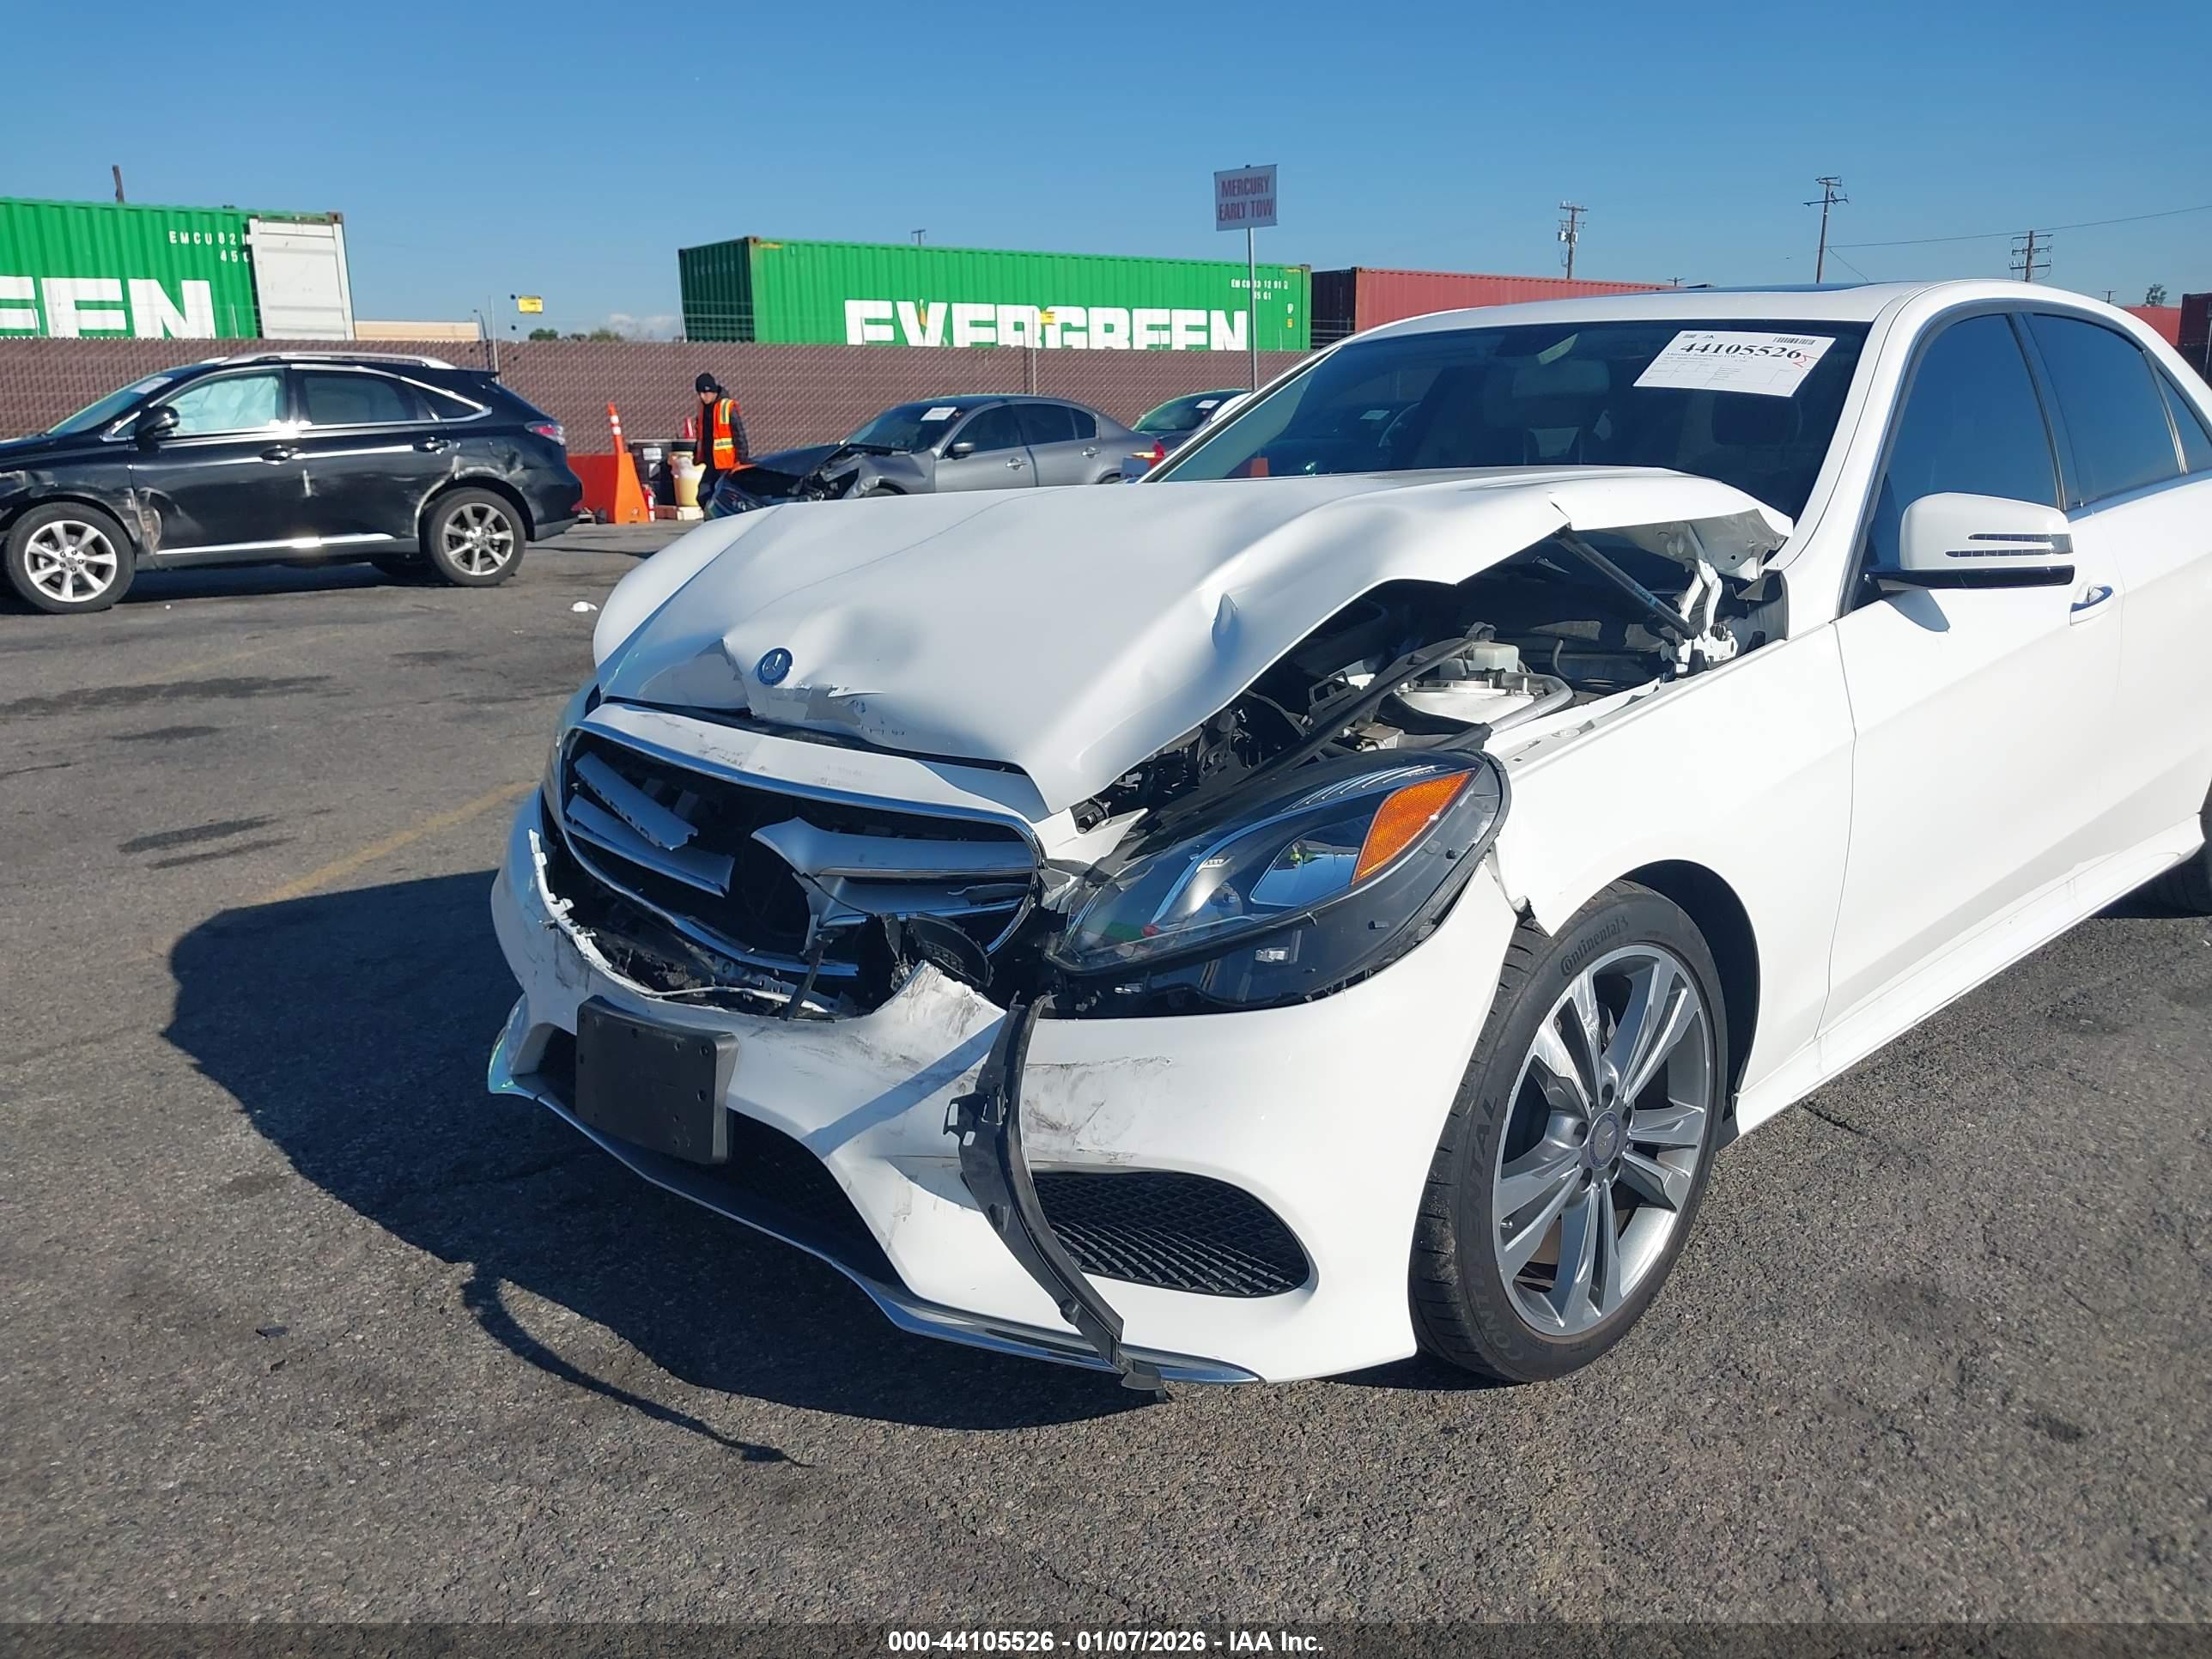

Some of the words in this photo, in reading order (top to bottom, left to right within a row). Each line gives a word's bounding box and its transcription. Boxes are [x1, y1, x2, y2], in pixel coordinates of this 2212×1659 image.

[1222, 175, 1270, 198] MERCURY
[1219, 201, 1247, 221] EARLY
[1250, 198, 1273, 218] TOW
[844, 299, 1248, 351] EVERGREEN
[1680, 342, 1804, 360] 44105526
[1560, 918, 1621, 976] Continental
